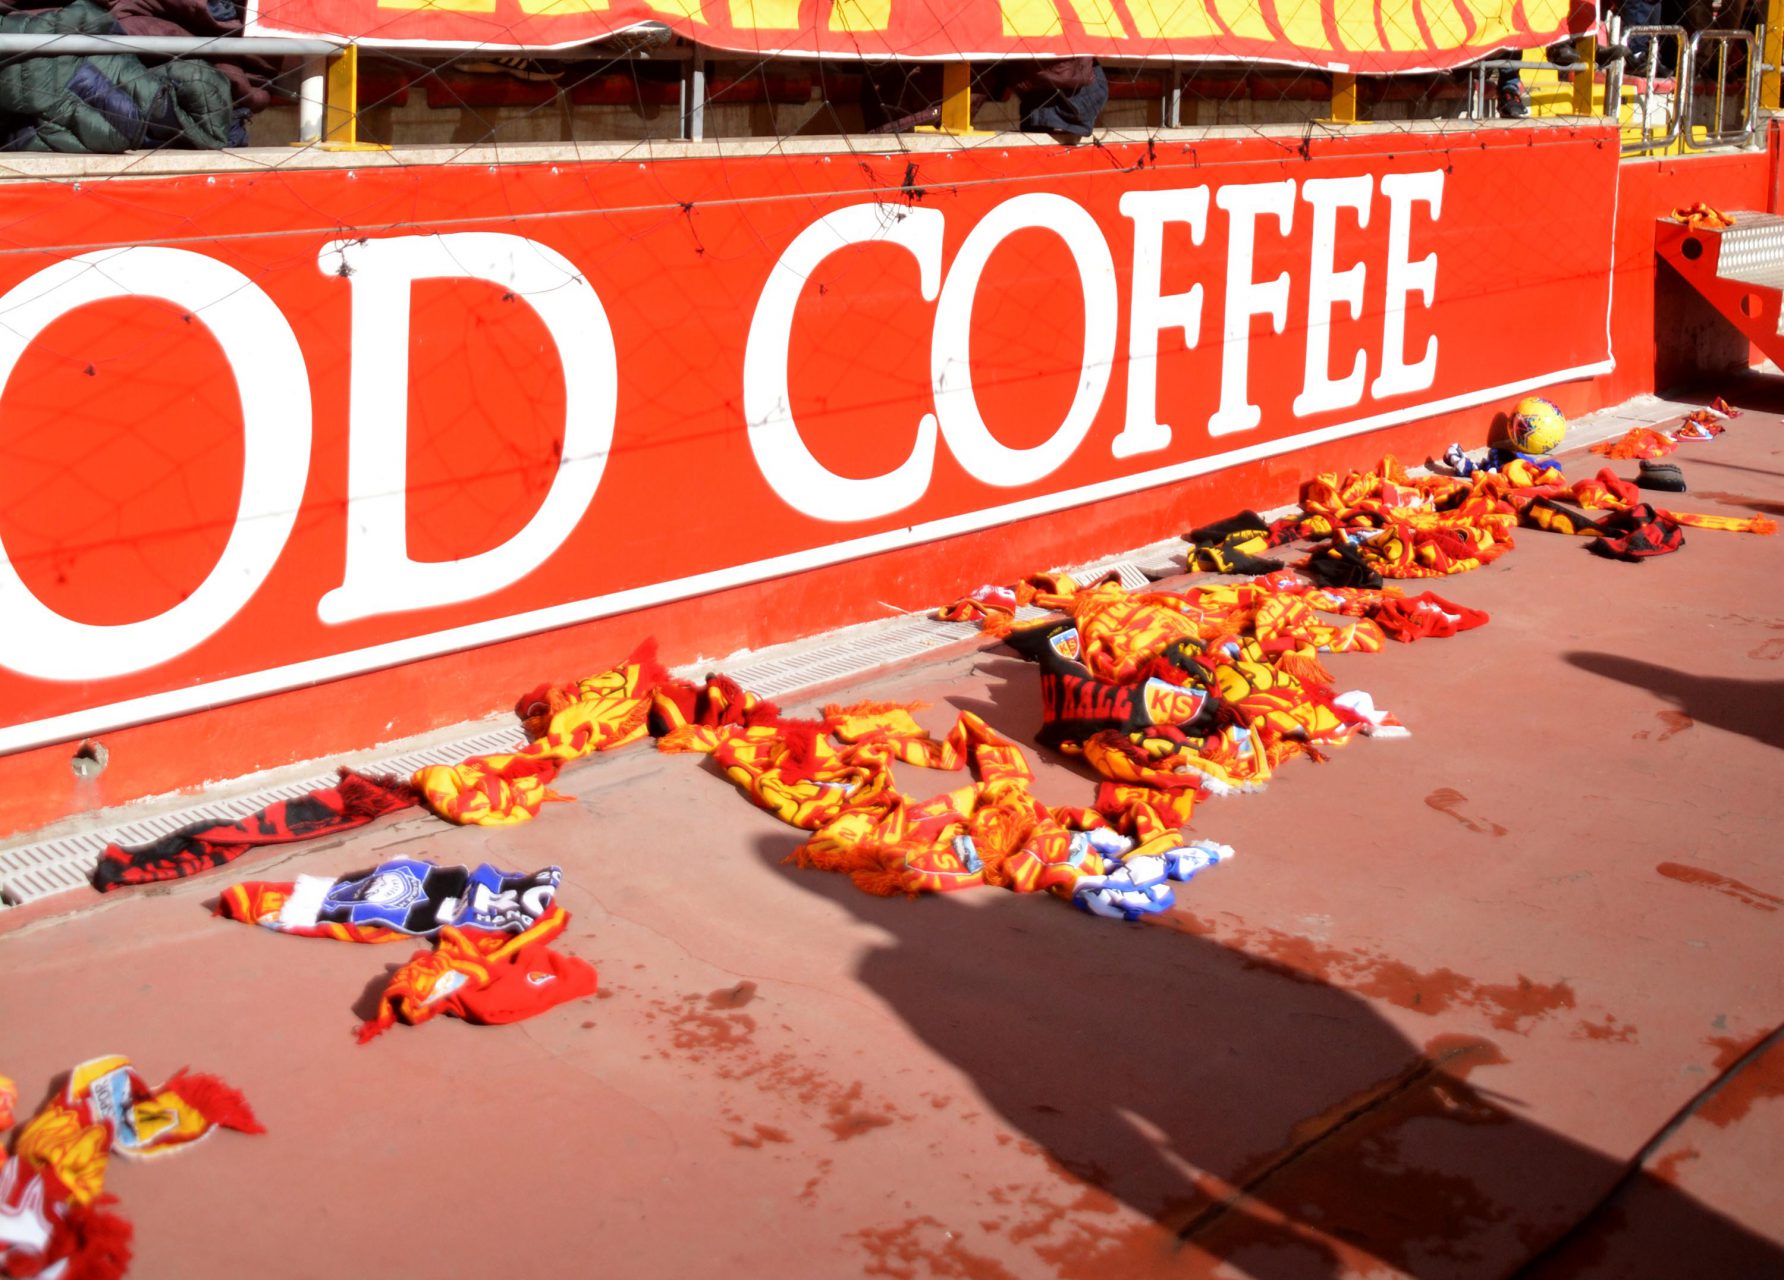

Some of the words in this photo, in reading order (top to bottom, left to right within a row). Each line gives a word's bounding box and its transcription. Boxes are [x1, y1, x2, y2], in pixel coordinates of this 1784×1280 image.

[0, 231, 618, 681] OD
[743, 169, 1445, 522] COFFEE
[1151, 689, 1193, 717] KS
